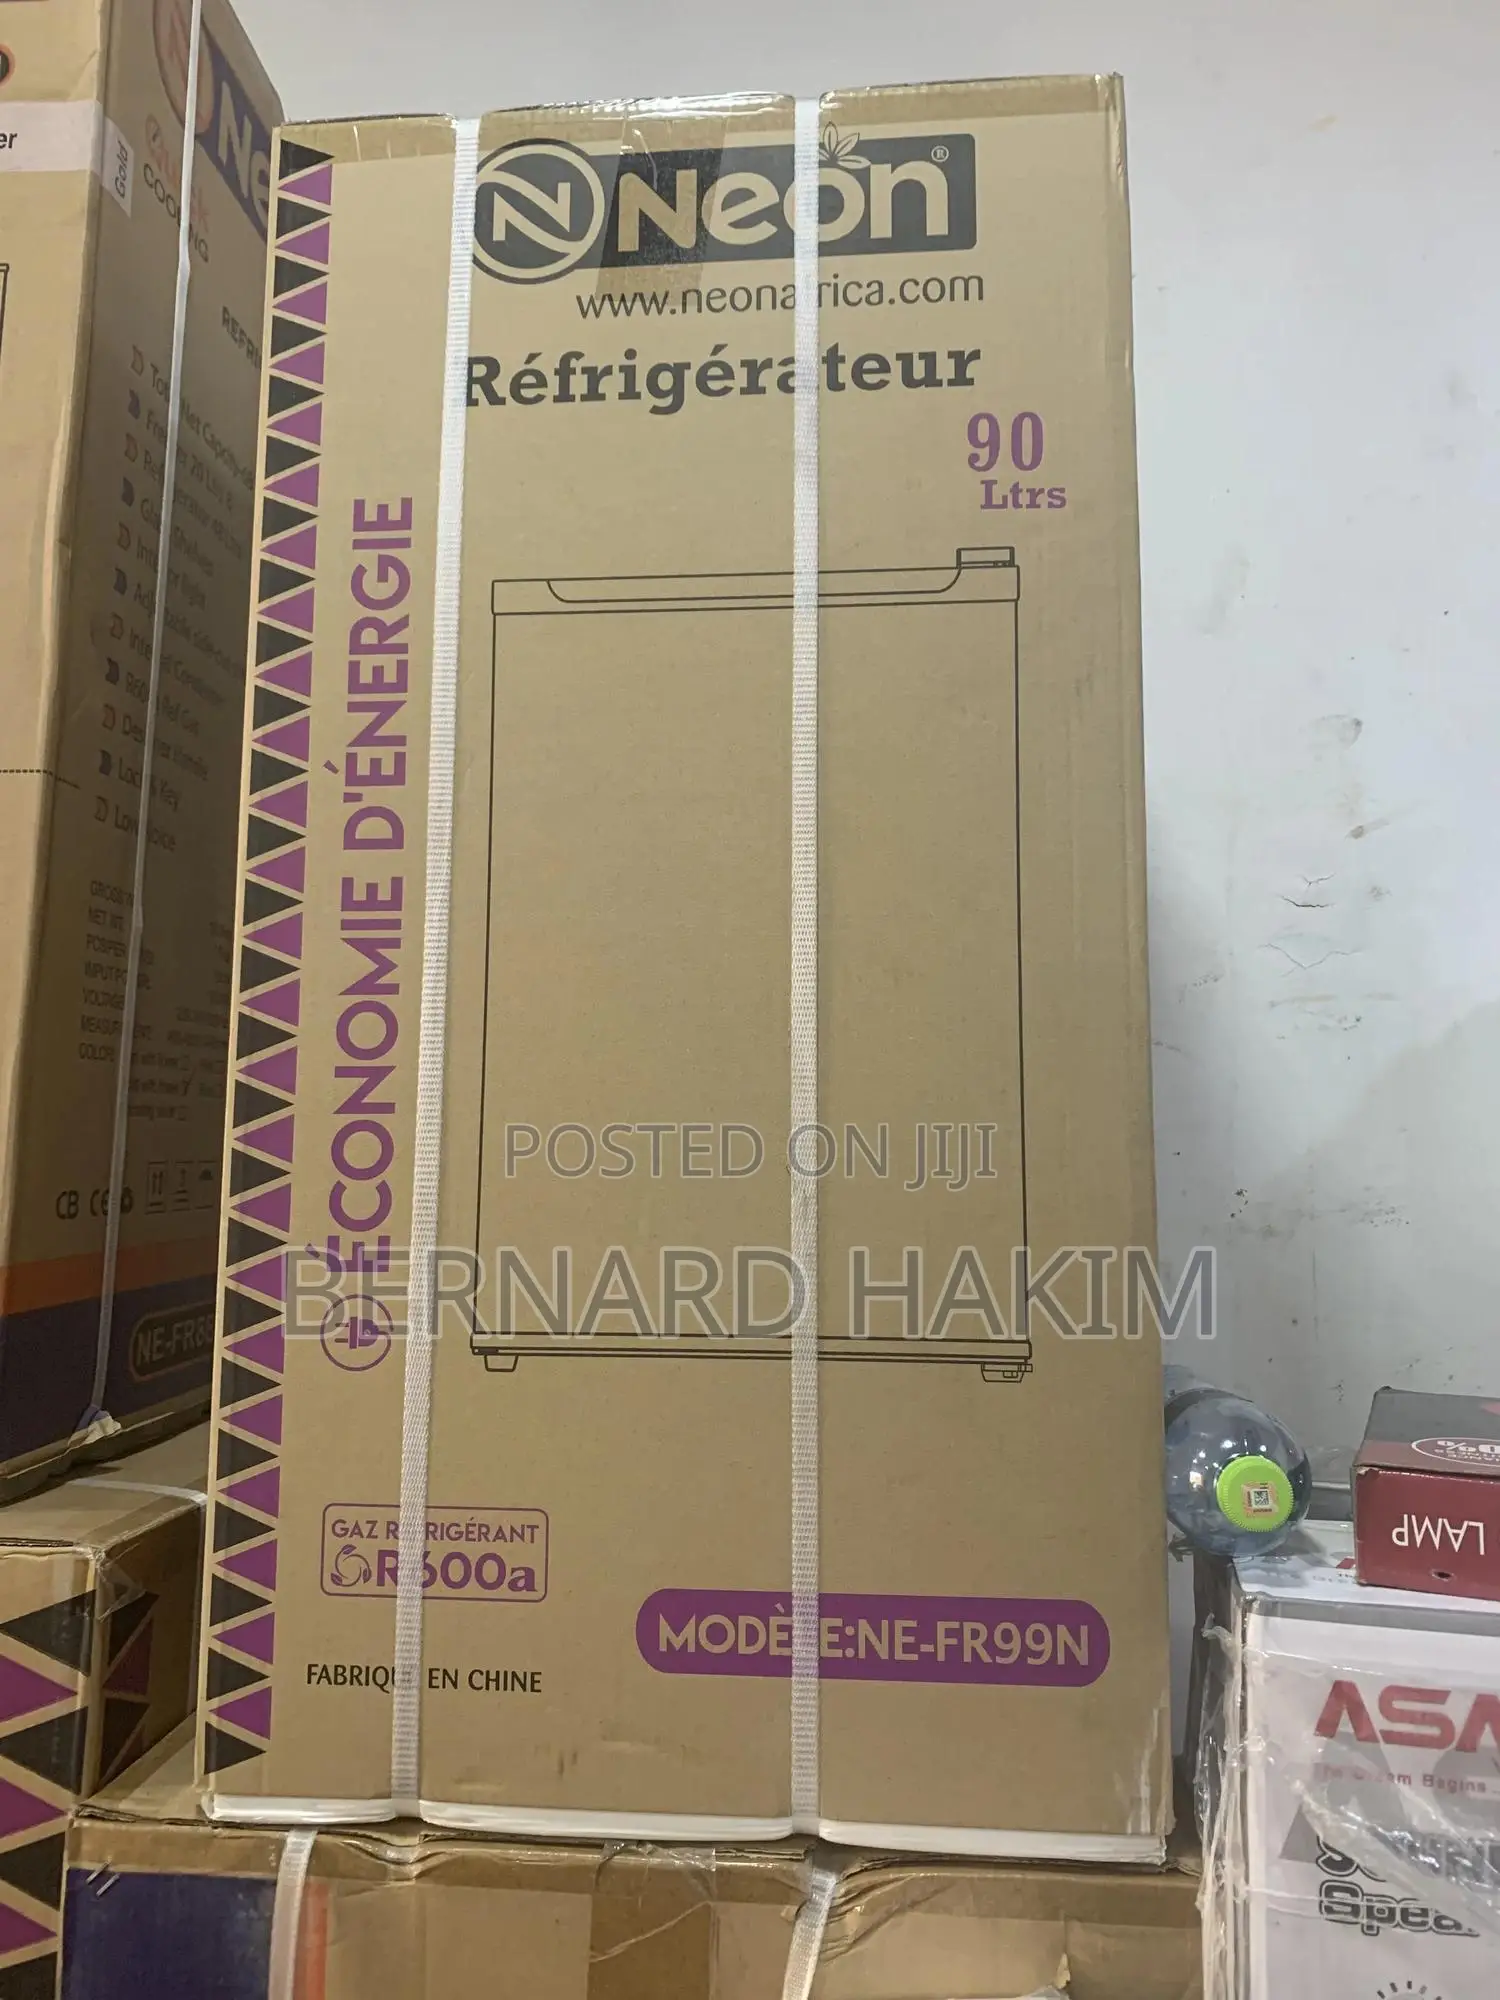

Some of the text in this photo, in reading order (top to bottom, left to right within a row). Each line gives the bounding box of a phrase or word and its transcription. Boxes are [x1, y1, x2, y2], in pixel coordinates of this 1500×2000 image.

[617, 159, 949, 252] Neon
[576, 274, 984, 319] www.neonarica.com
[966, 412, 1045, 473] 90
[980, 480, 1067, 511] Ltrs
[305, 496, 413, 1273] ÉCONOMIE D'ÉNERGIE
[331, 1516, 540, 1544] GAZ RRIGÉRANT
[1391, 1513, 1485, 1556] LAMP
[658, 1602, 1088, 1666] MODÈE:NE-FR99N
[306, 1663, 542, 1694] FABRIQ EN CHINE
[1319, 1879, 1480, 1937] Spea
